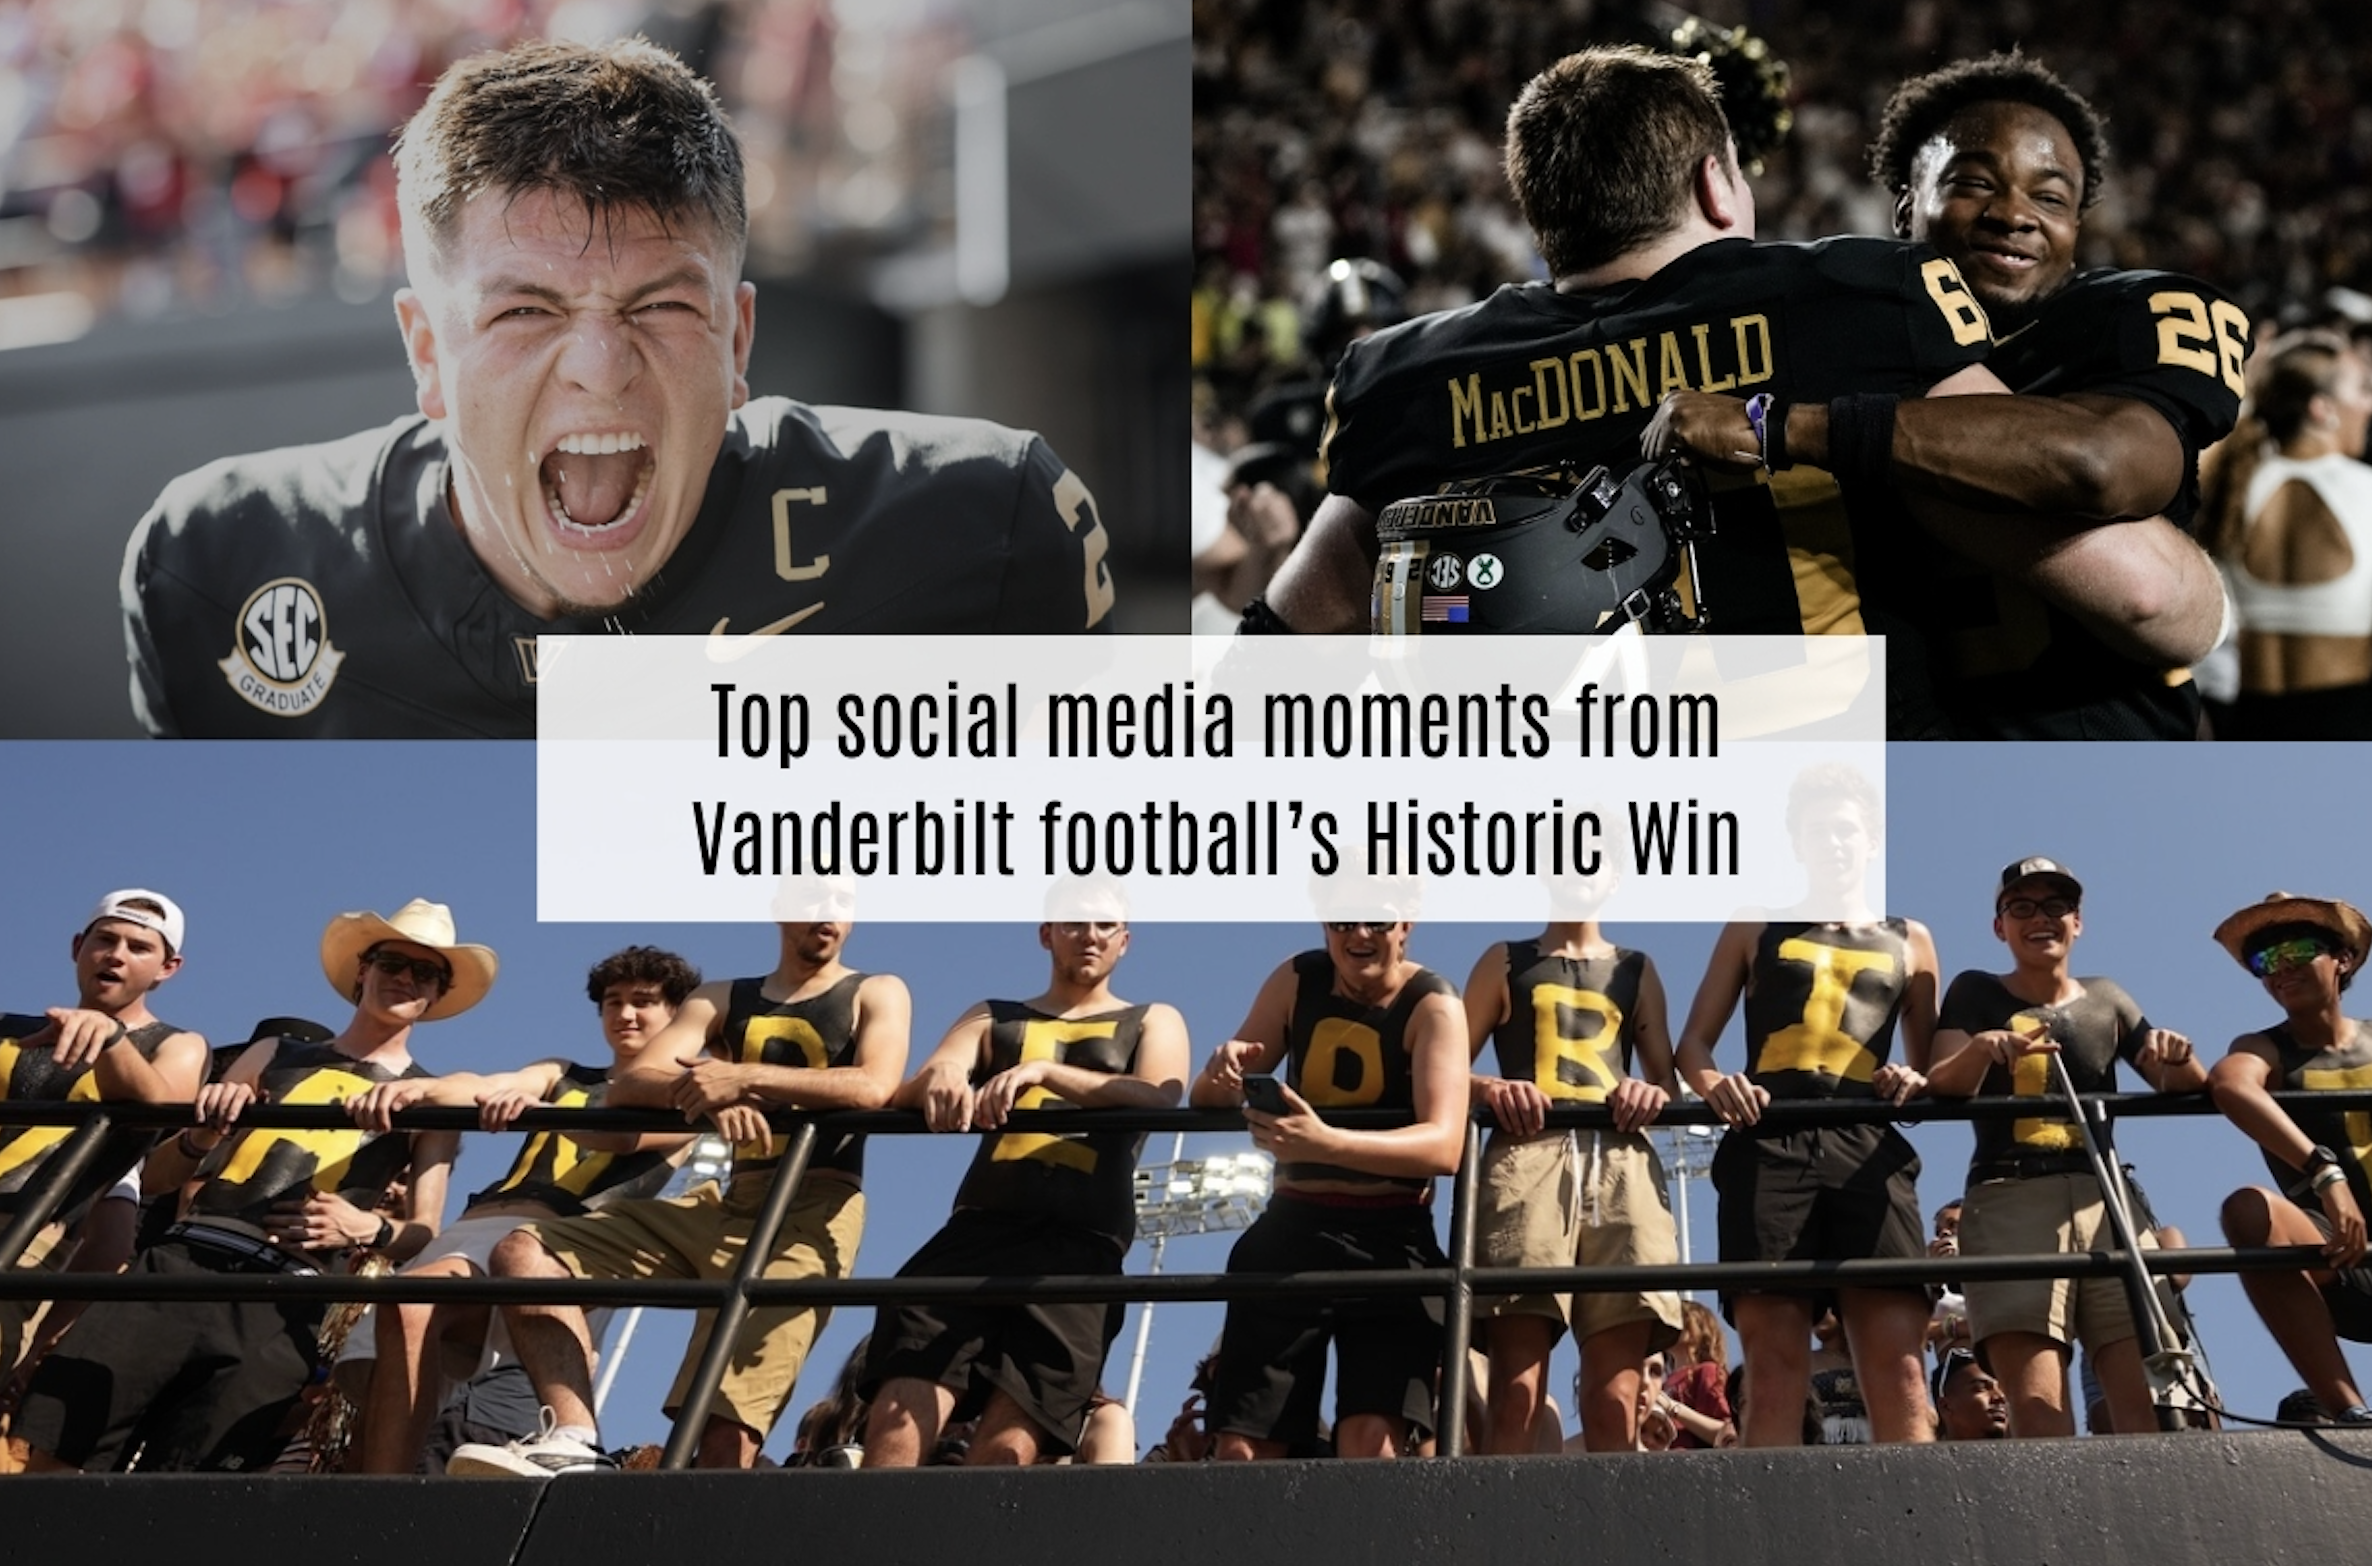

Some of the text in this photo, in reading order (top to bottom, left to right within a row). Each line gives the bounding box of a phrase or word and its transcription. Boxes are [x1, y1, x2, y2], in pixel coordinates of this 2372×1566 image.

[2147, 292, 2250, 399] 26
[771, 486, 830, 582] C
[244, 584, 319, 680] SEC
[239, 671, 326, 711] GRADUATE
[1532, 983, 1623, 1104] B
[1756, 937, 1895, 1083] I
